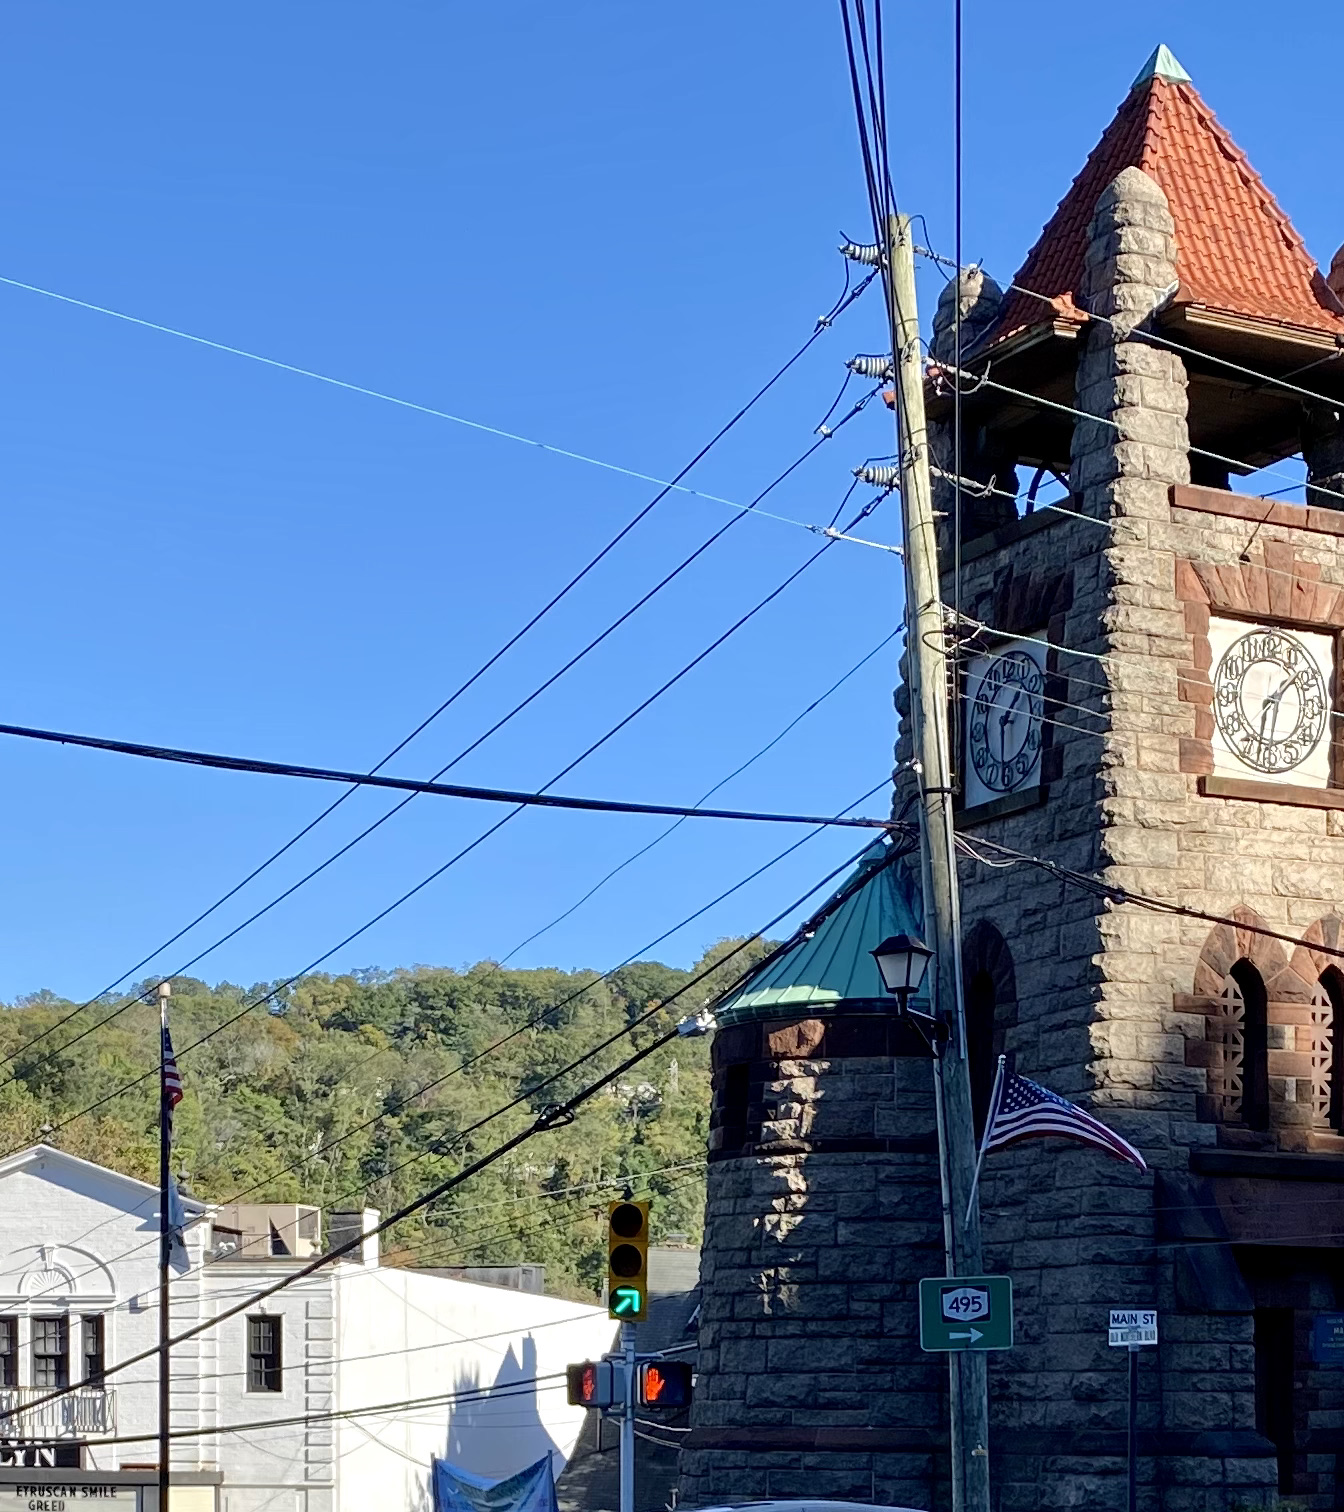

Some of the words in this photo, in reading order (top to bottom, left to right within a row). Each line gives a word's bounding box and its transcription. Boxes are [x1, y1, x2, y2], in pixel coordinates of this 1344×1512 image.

[948, 1296, 982, 1314] 495
[1112, 1314, 1138, 1324] MAIN
[1142, 1314, 1155, 1324] ST
[16, 1486, 77, 1498] ETRUSCAN
[82, 1486, 117, 1498] SMILE
